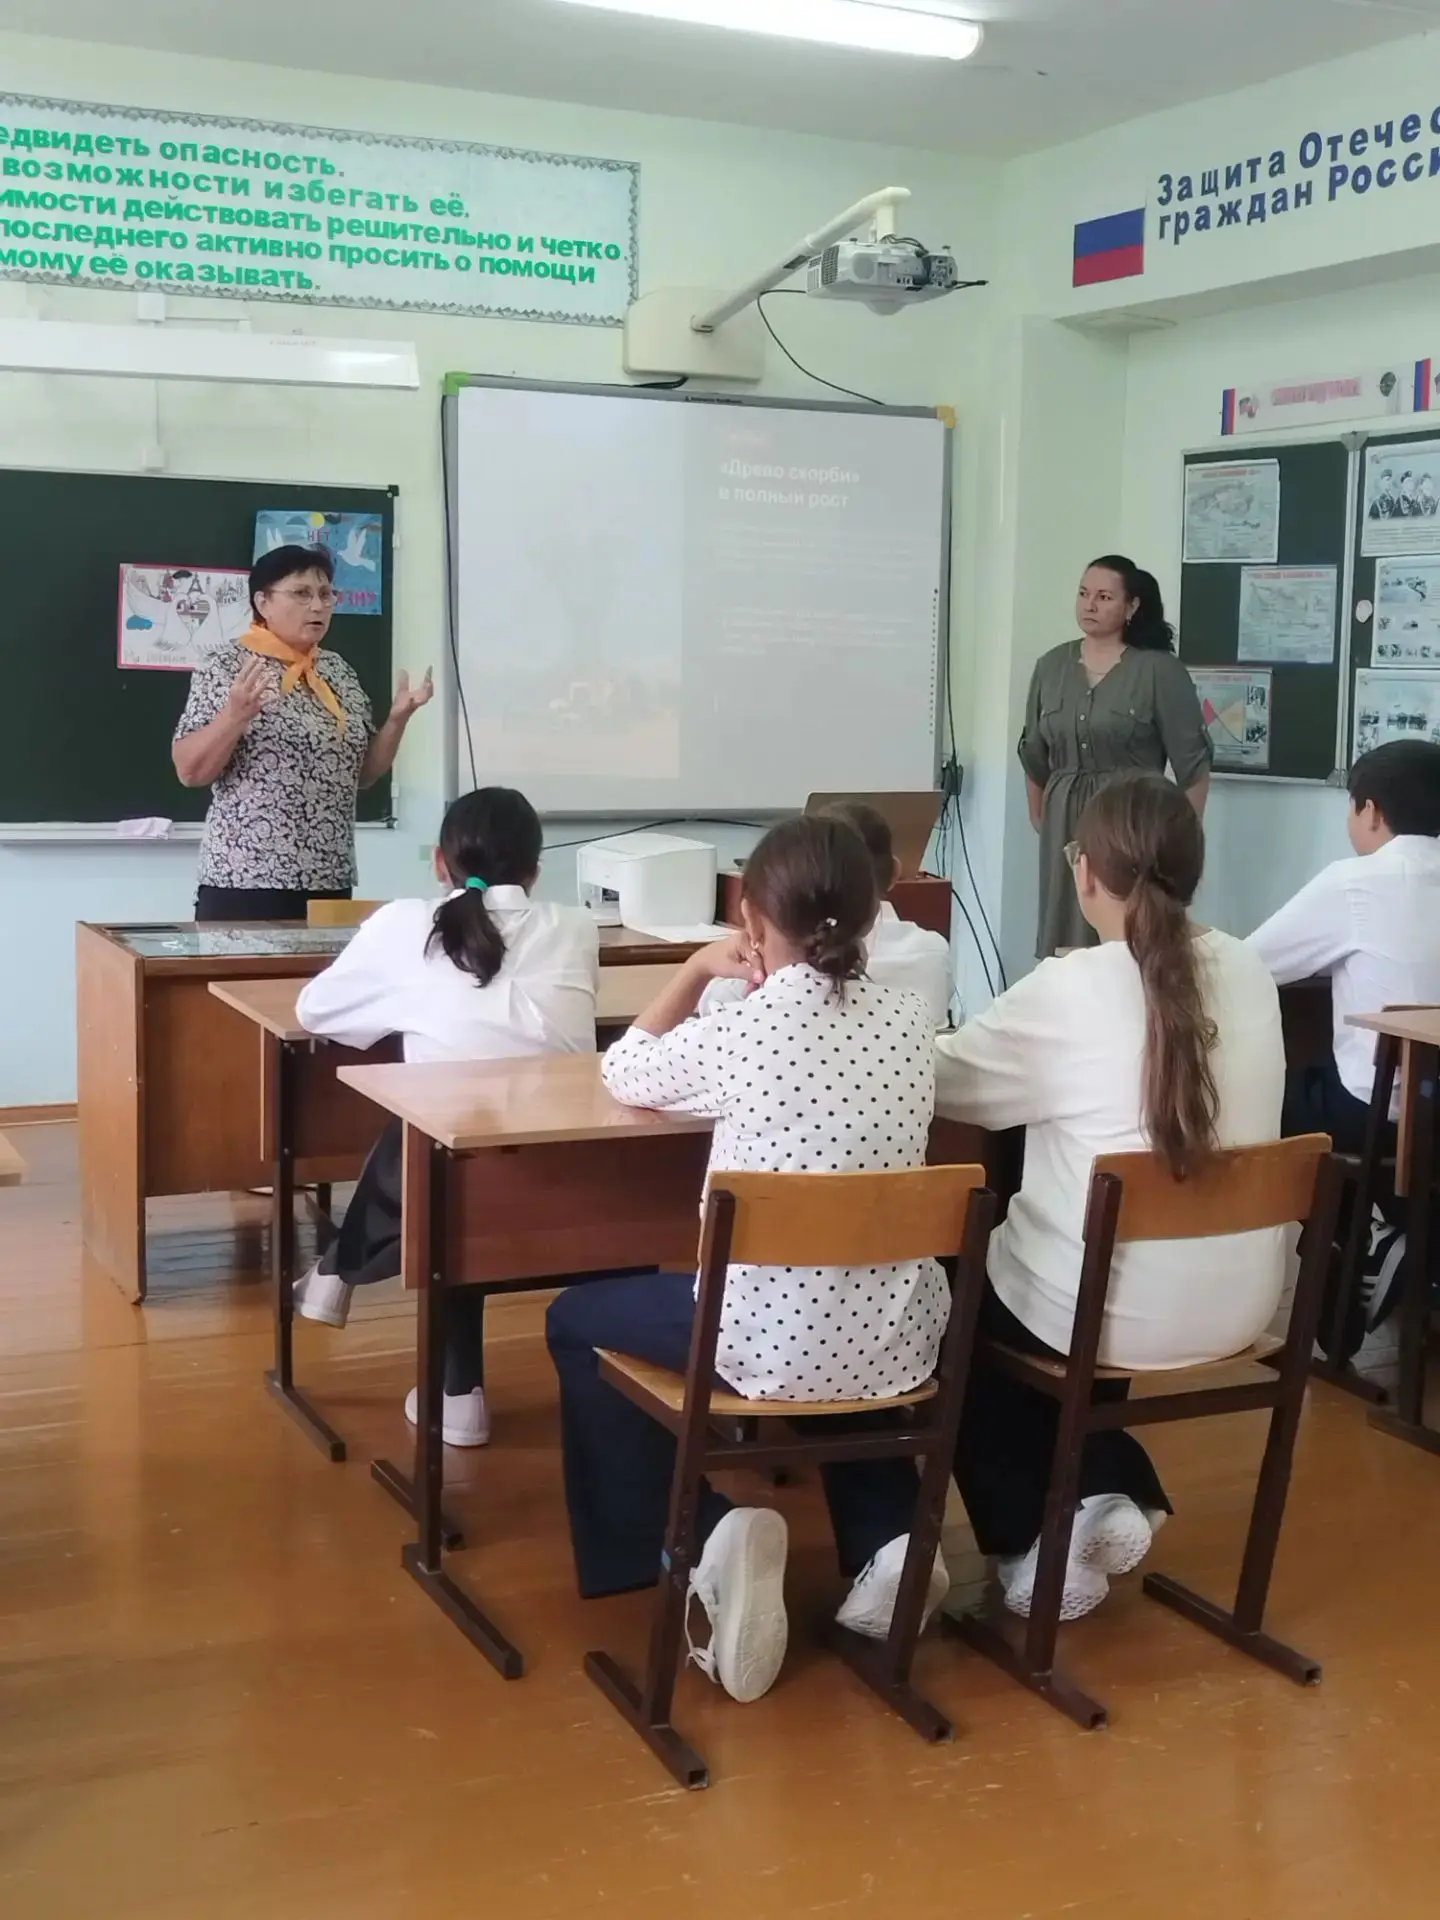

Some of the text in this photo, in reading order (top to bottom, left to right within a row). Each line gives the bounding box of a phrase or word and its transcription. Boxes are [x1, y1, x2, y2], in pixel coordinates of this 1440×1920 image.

[159, 141, 345, 176] опасность.
[1157, 150, 1286, 206] Защита
[2, 156, 470, 219] возможности избегать её.
[1159, 180, 1314, 246] граждан
[123, 194, 322, 233] действовать
[326, 215, 512, 252] решительно
[517, 236, 534, 254] и
[89, 254, 128, 276] её
[134, 258, 321, 292] оказывать.
[196, 232, 323, 261] активно
[328, 243, 450, 271] просить
[454, 254, 472, 273] о
[478, 256, 596, 286] помощи
